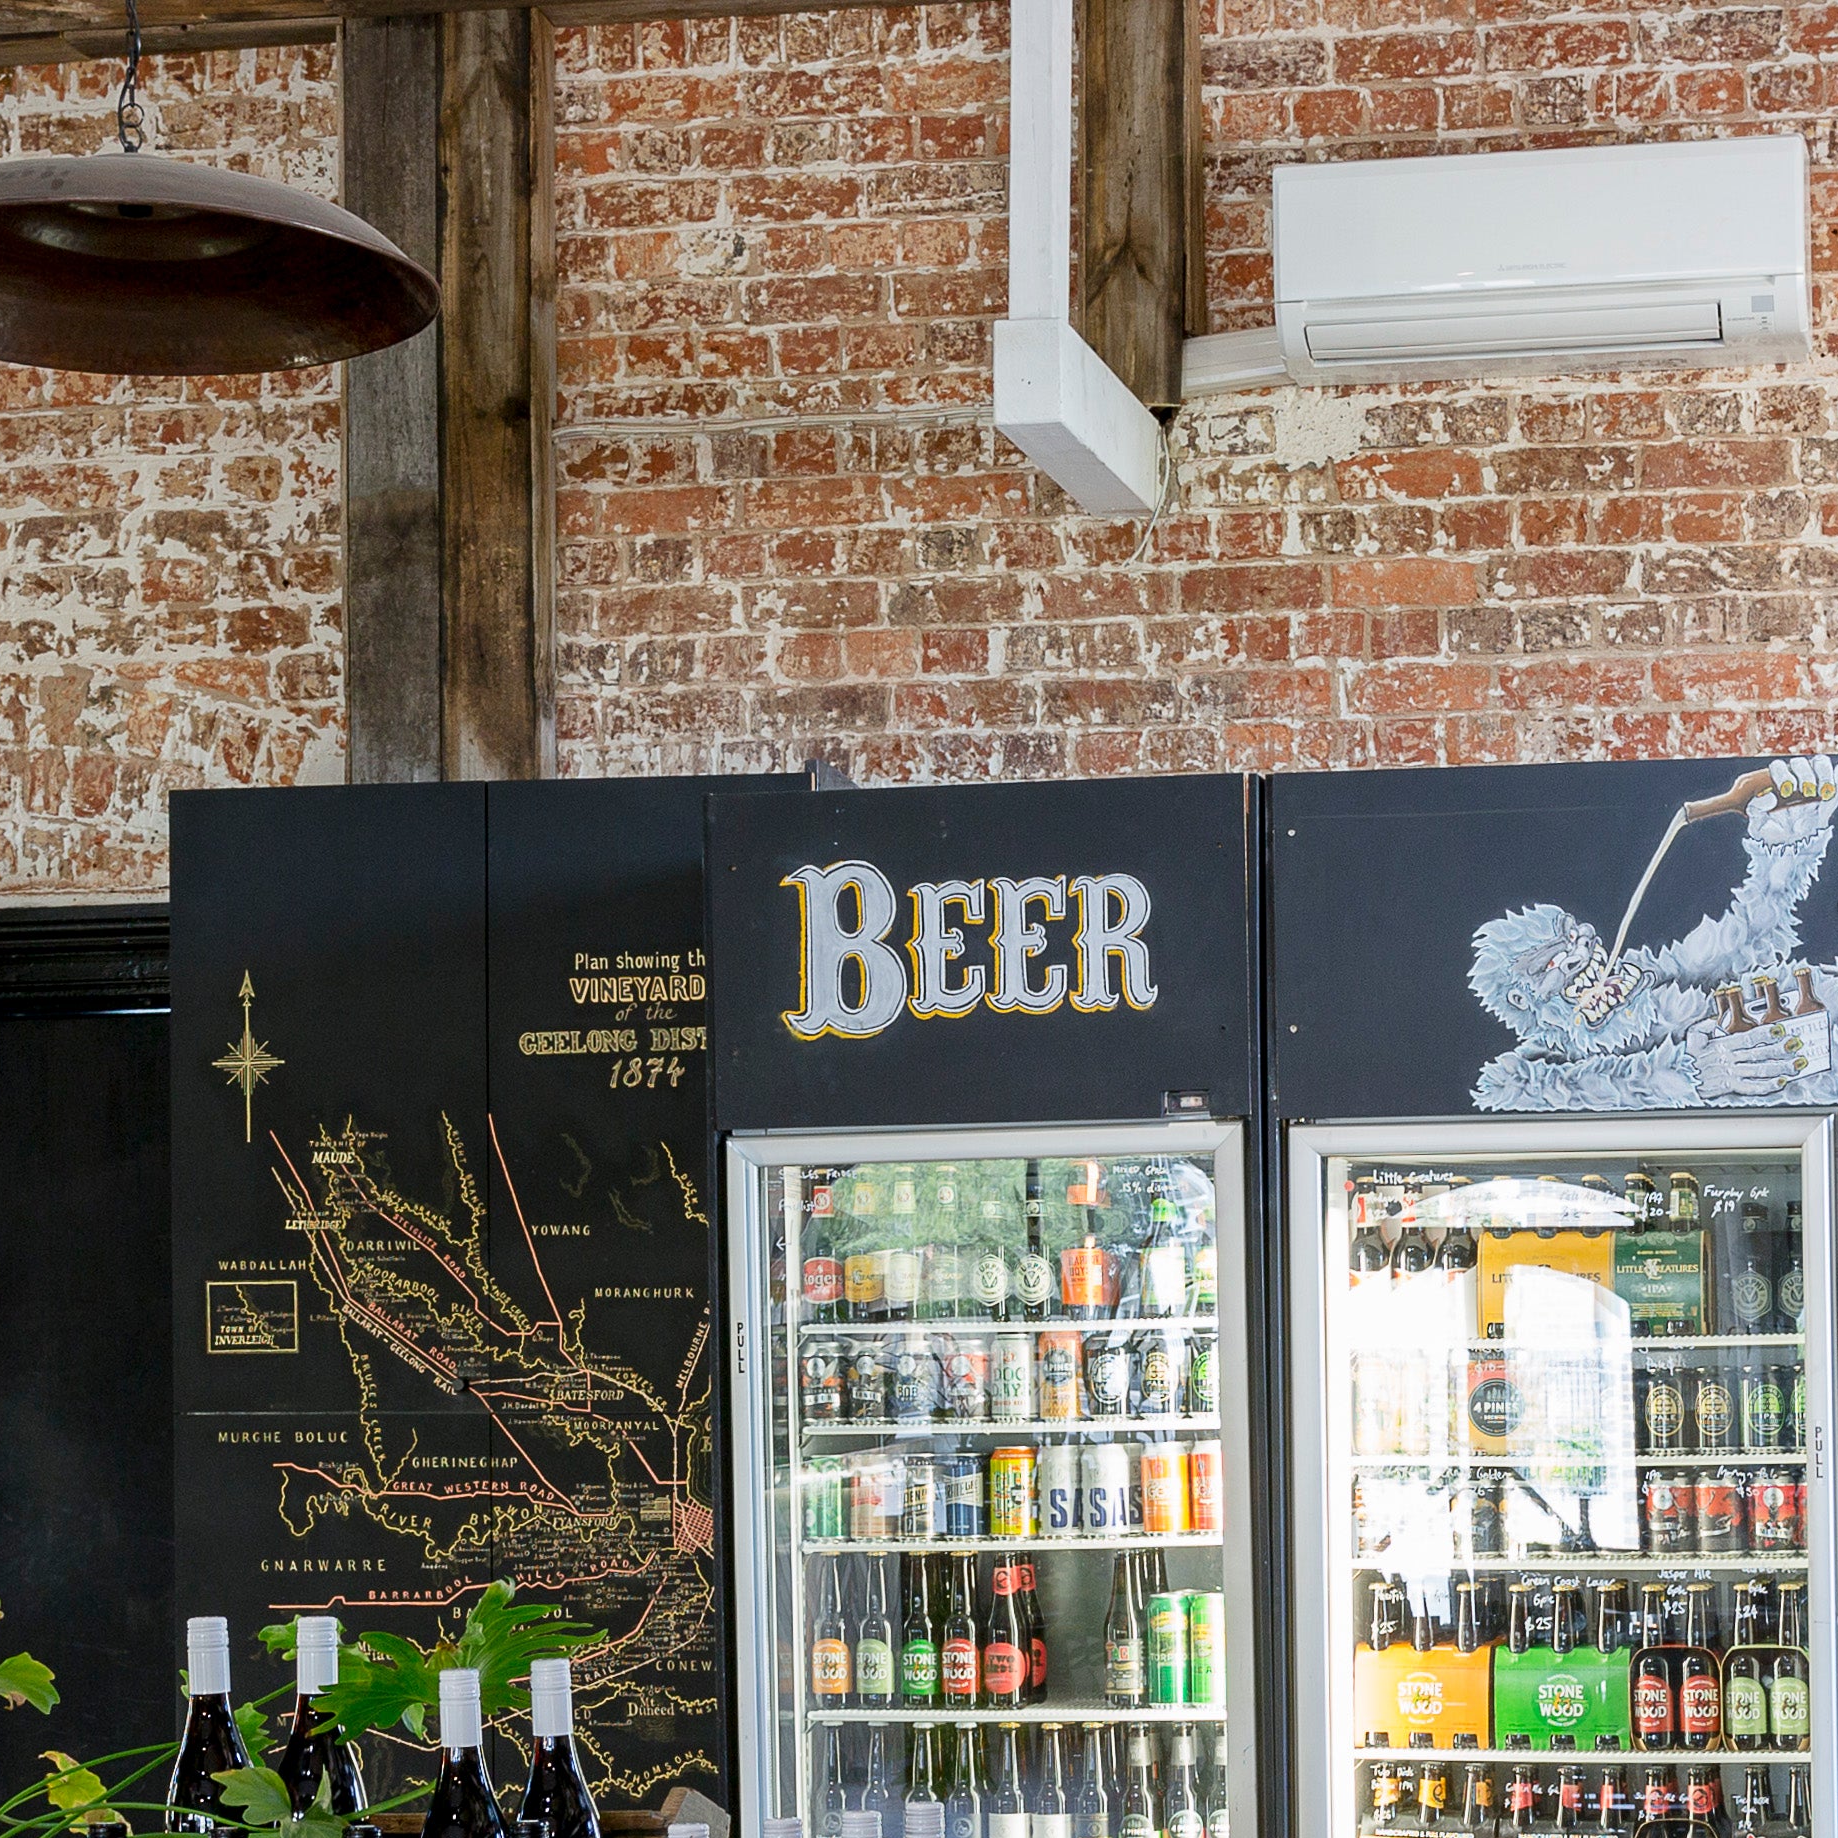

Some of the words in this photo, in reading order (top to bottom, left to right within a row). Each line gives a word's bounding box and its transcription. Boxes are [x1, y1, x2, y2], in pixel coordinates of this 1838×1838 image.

[782, 858, 1158, 1040] BEER
[575, 952, 609, 970] Plan
[616, 951, 680, 973] showing
[615, 1002, 637, 1021] of
[645, 1001, 677, 1020] the
[519, 1028, 638, 1055] GEELONG
[609, 1056, 685, 1088] 1874
[312, 1151, 356, 1164] MAUDE
[1703, 1184, 1746, 1200] Furphy
[1712, 1201, 1736, 1218] $19
[531, 1225, 591, 1236] YOWANG
[347, 1240, 421, 1252] DARRIWIL
[218, 1260, 307, 1271] WABDALLAH
[443, 1254, 466, 1279] ROAD
[451, 1302, 484, 1333] RIVER
[368, 1302, 419, 1341] BALLARAT
[429, 1346, 457, 1370] ROAD
[342, 1304, 384, 1341] BALLARAT
[389, 1336, 426, 1375] GEELONG
[433, 1376, 458, 1396] RAIL
[675, 1320, 708, 1390] MELBOURNE
[736, 1321, 745, 1374] PULL
[556, 1389, 624, 1401] BATESFORD
[573, 1419, 660, 1431] MOORPANYAL
[218, 1431, 281, 1443] MURGHE
[294, 1431, 348, 1443] BOLUC
[1814, 1426, 1823, 1478] PULL
[412, 1456, 518, 1468] GHERINEGHAP
[393, 1481, 433, 1492] GREAT
[444, 1480, 510, 1494] WESTERN
[520, 1481, 555, 1501] ROAD
[380, 1503, 433, 1528] RIVER
[470, 1504, 543, 1526] BARWON
[261, 1559, 386, 1572] GNARWARRE
[369, 1575, 472, 1600] BARRARBOOL
[516, 1571, 566, 1584] HILLS
[590, 1560, 630, 1573] ROAD
[813, 1653, 847, 1666] STONE
[903, 1653, 937, 1666] STONE
[942, 1652, 975, 1665] STONE
[813, 1666, 847, 1681] WOOD
[903, 1666, 937, 1681] WOOD
[942, 1665, 975, 1680] WOOD
[1397, 1682, 1443, 1700] STONE
[1538, 1683, 1584, 1701] STONE
[1683, 1687, 1719, 1703] STONE
[1397, 1699, 1443, 1715] WOOD
[1539, 1700, 1584, 1717] WOOD
[1684, 1701, 1719, 1718] WOOD
